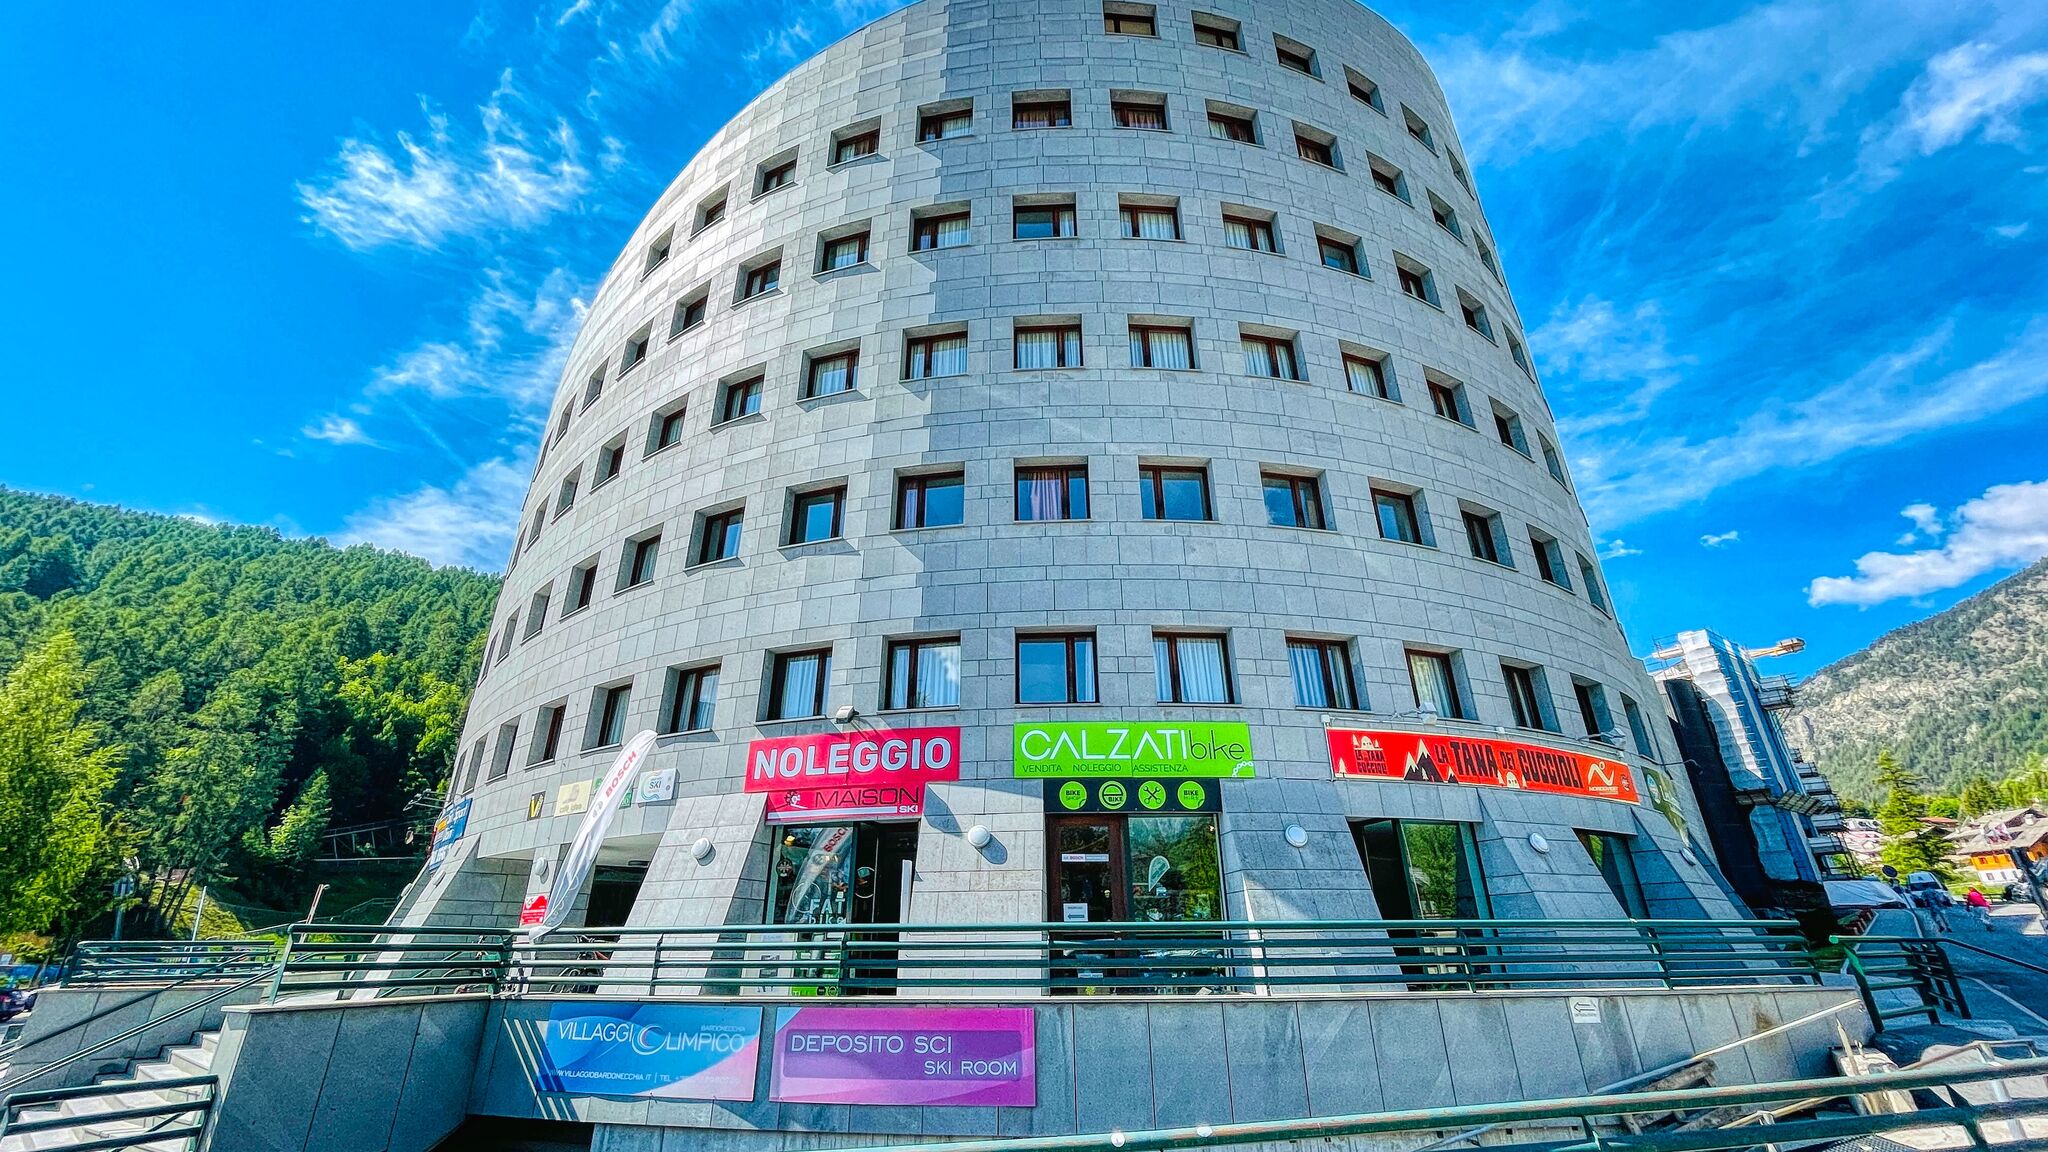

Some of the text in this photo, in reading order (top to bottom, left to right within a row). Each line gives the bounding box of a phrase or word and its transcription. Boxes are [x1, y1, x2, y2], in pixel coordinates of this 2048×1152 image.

[753, 737, 952, 780] NOLEGGIO
[1434, 742, 1584, 788] LA TANA DEI CUCCIOLI
[605, 751, 637, 798] BOSCH
[1022, 763, 1188, 773] VENDITA NOLEGGIO ASSISTENZA
[649, 780, 662, 790] SKI
[815, 786, 919, 808] MAISON
[899, 804, 919, 814] SKI
[810, 898, 846, 914] FAT
[791, 1034, 952, 1054] DEPOSITO SCI
[924, 1060, 1017, 1076] SKI ROOM
[659, 1074, 672, 1082] TEL
